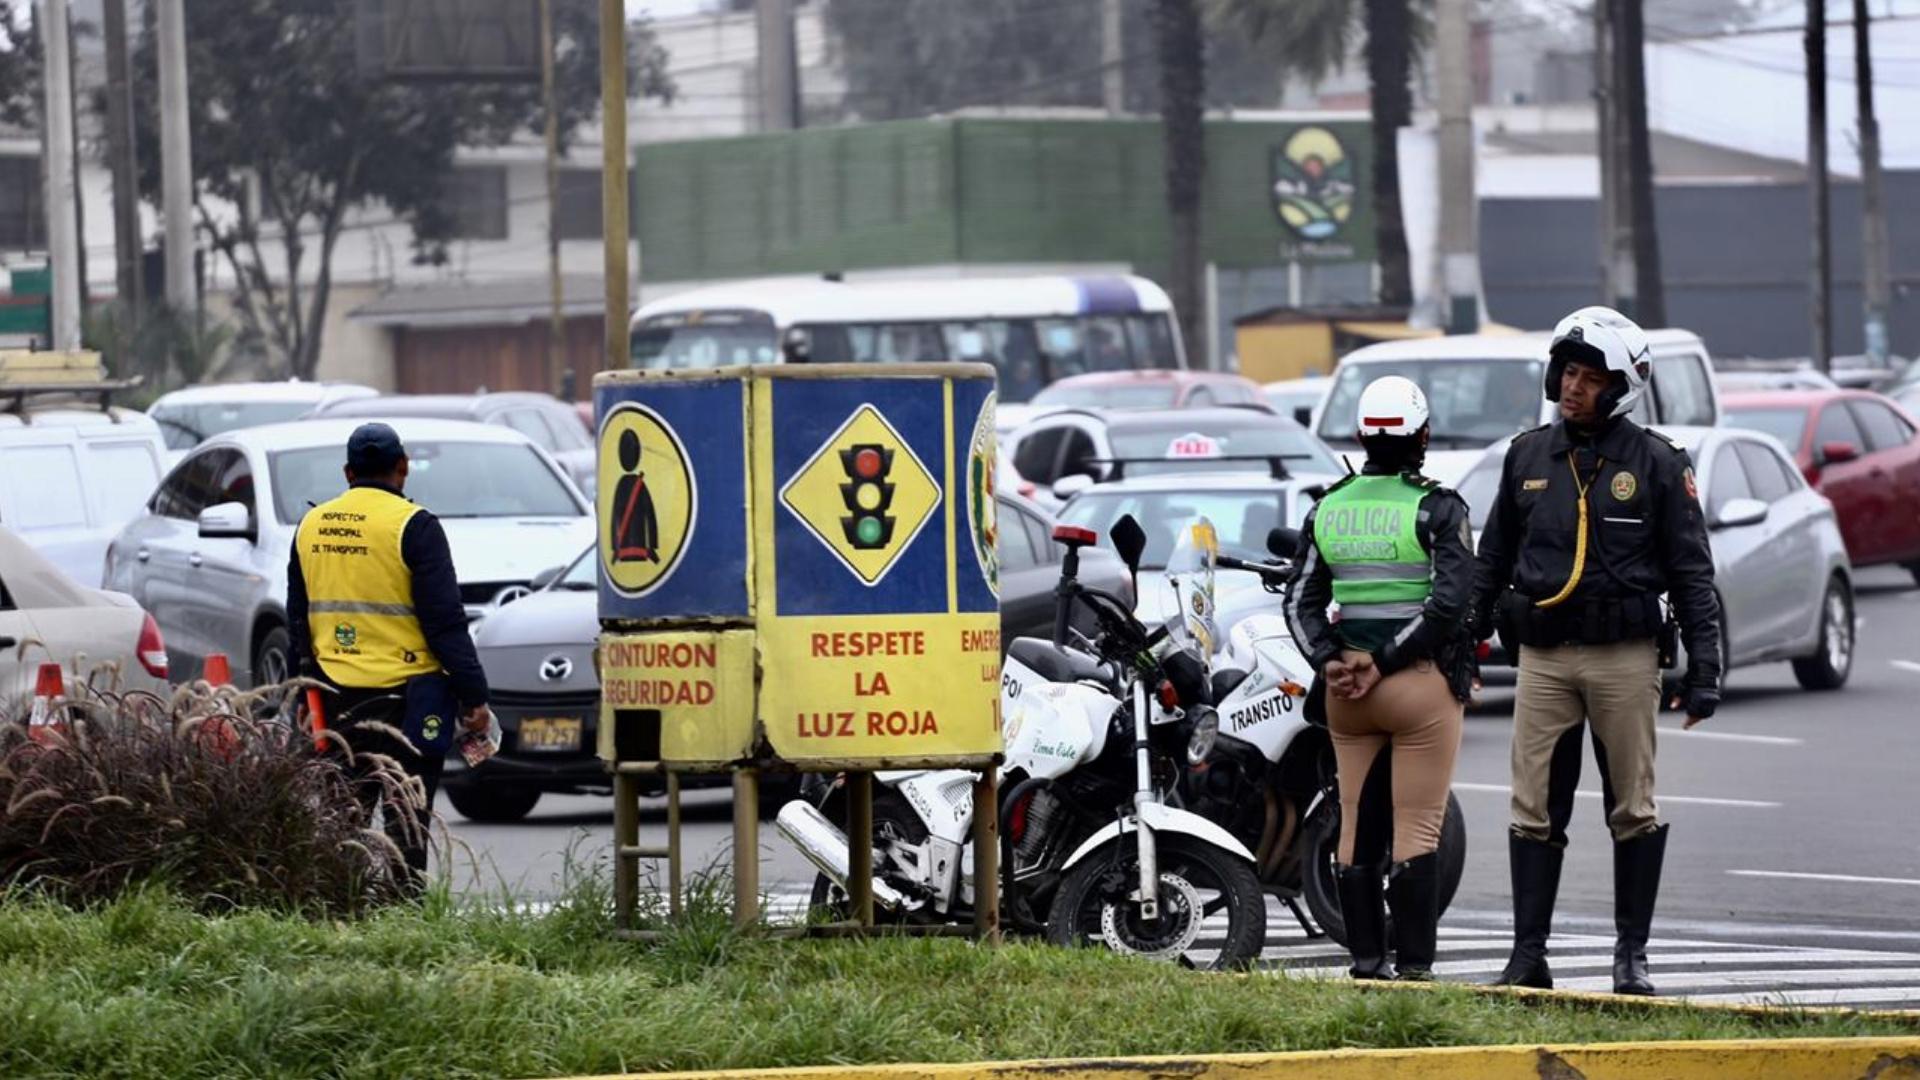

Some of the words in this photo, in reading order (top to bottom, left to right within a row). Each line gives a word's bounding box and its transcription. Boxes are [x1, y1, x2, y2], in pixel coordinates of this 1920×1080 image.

[1176, 441, 1209, 455] TAXI
[321, 512, 367, 522] INSPECTOR
[1323, 506, 1402, 538] POLICIA
[318, 527, 363, 538] MUNICIPAL
[312, 544, 320, 553] DE
[322, 544, 368, 556] TRANSPORTE
[607, 642, 716, 668] CINTURON
[811, 631, 925, 657] RESPETE
[855, 671, 890, 696] LA
[798, 711, 855, 738] LUZ
[867, 710, 938, 737] ROJA
[1230, 693, 1293, 733] TRANSITO
